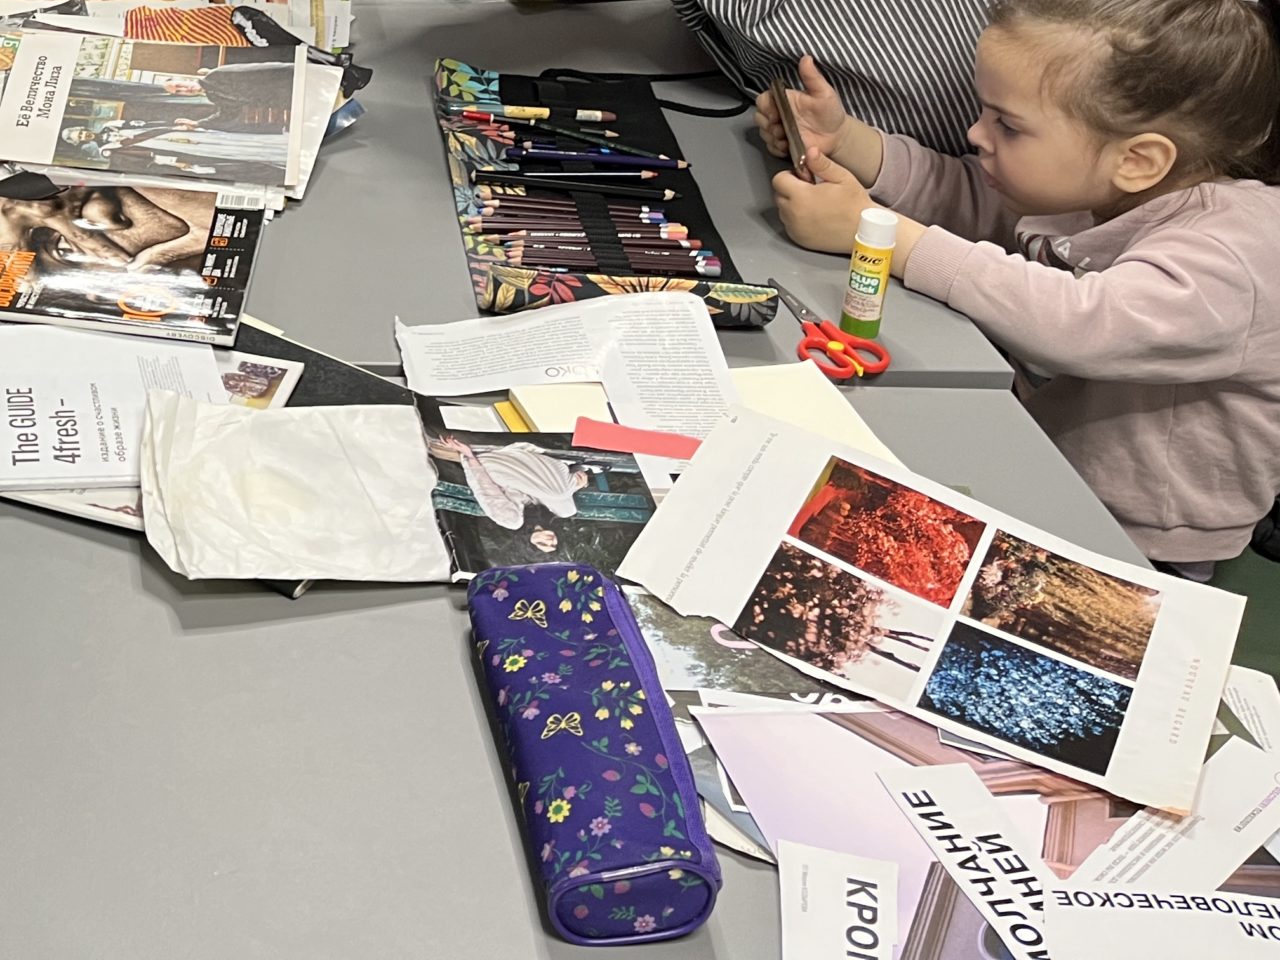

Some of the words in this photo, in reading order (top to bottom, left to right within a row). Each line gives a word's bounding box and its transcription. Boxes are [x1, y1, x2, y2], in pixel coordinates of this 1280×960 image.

[20, 55, 48, 112] Величество
[37, 90, 57, 119] Мона
[49, 65, 62, 91] Лиза
[16, 111, 30, 128] Её
[166, 332, 216, 342] DISCOVERY
[6, 387, 37, 429] GUIDE
[12, 432, 40, 466] The
[49, 410, 81, 464] 4fresh
[97, 427, 110, 462] издание
[114, 432, 128, 462] образе
